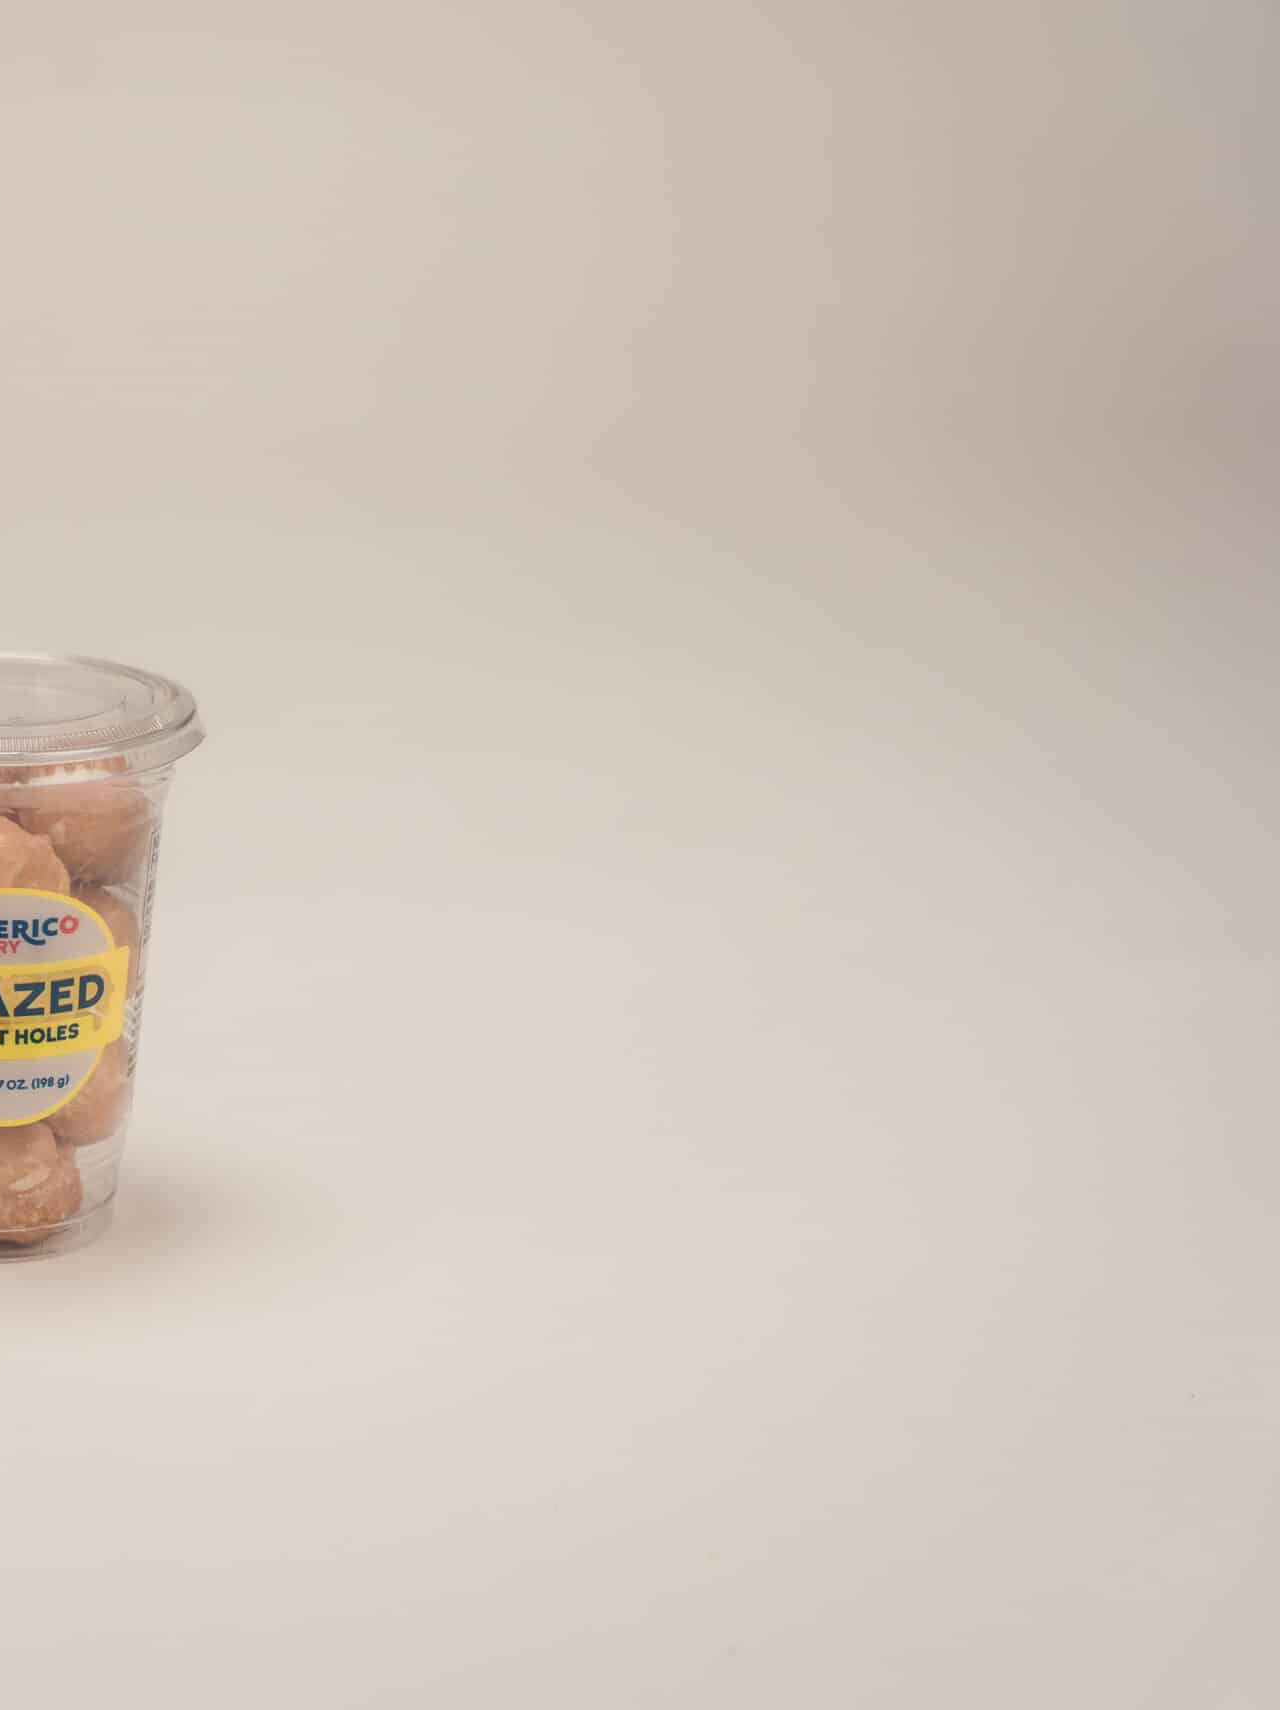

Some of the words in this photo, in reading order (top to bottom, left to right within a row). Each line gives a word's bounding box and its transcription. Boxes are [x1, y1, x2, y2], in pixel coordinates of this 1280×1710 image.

[15, 1023, 80, 1044] HOLES
[6, 1079, 28, 1090] OZ.
[31, 1076, 55, 1090] (198
[56, 1073, 70, 1089] g)
